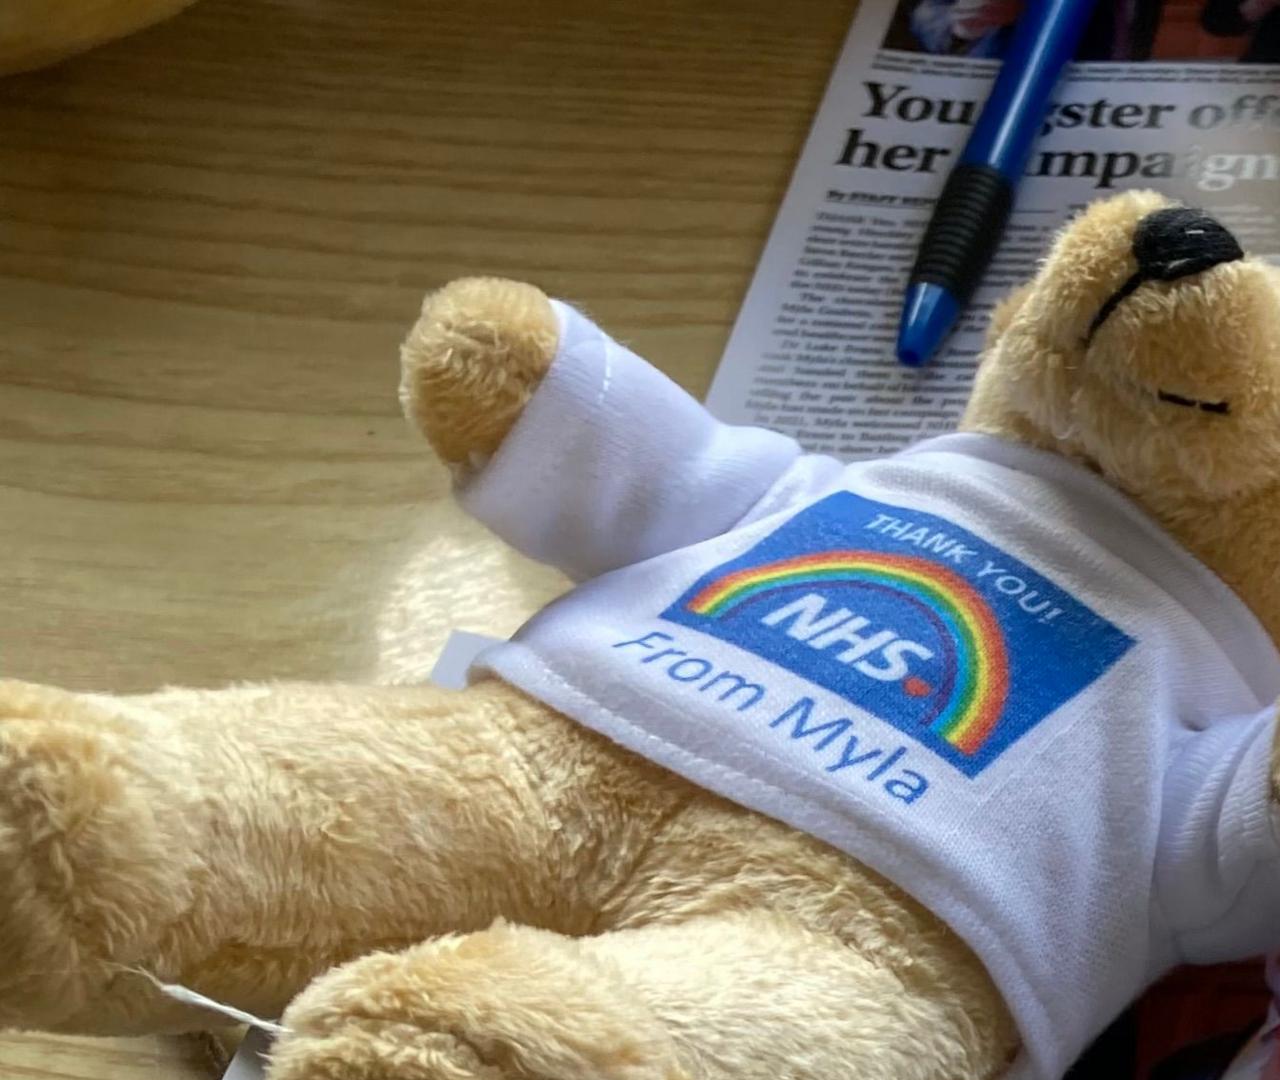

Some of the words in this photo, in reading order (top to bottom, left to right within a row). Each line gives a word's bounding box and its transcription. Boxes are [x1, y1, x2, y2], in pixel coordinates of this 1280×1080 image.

[836, 128, 951, 173] her
[862, 82, 1174, 136] Youster
[865, 513, 980, 564] THANK
[976, 559, 1063, 625] YOU!
[762, 593, 932, 684] NHS
[613, 630, 765, 712] From
[771, 695, 931, 805] Myla
